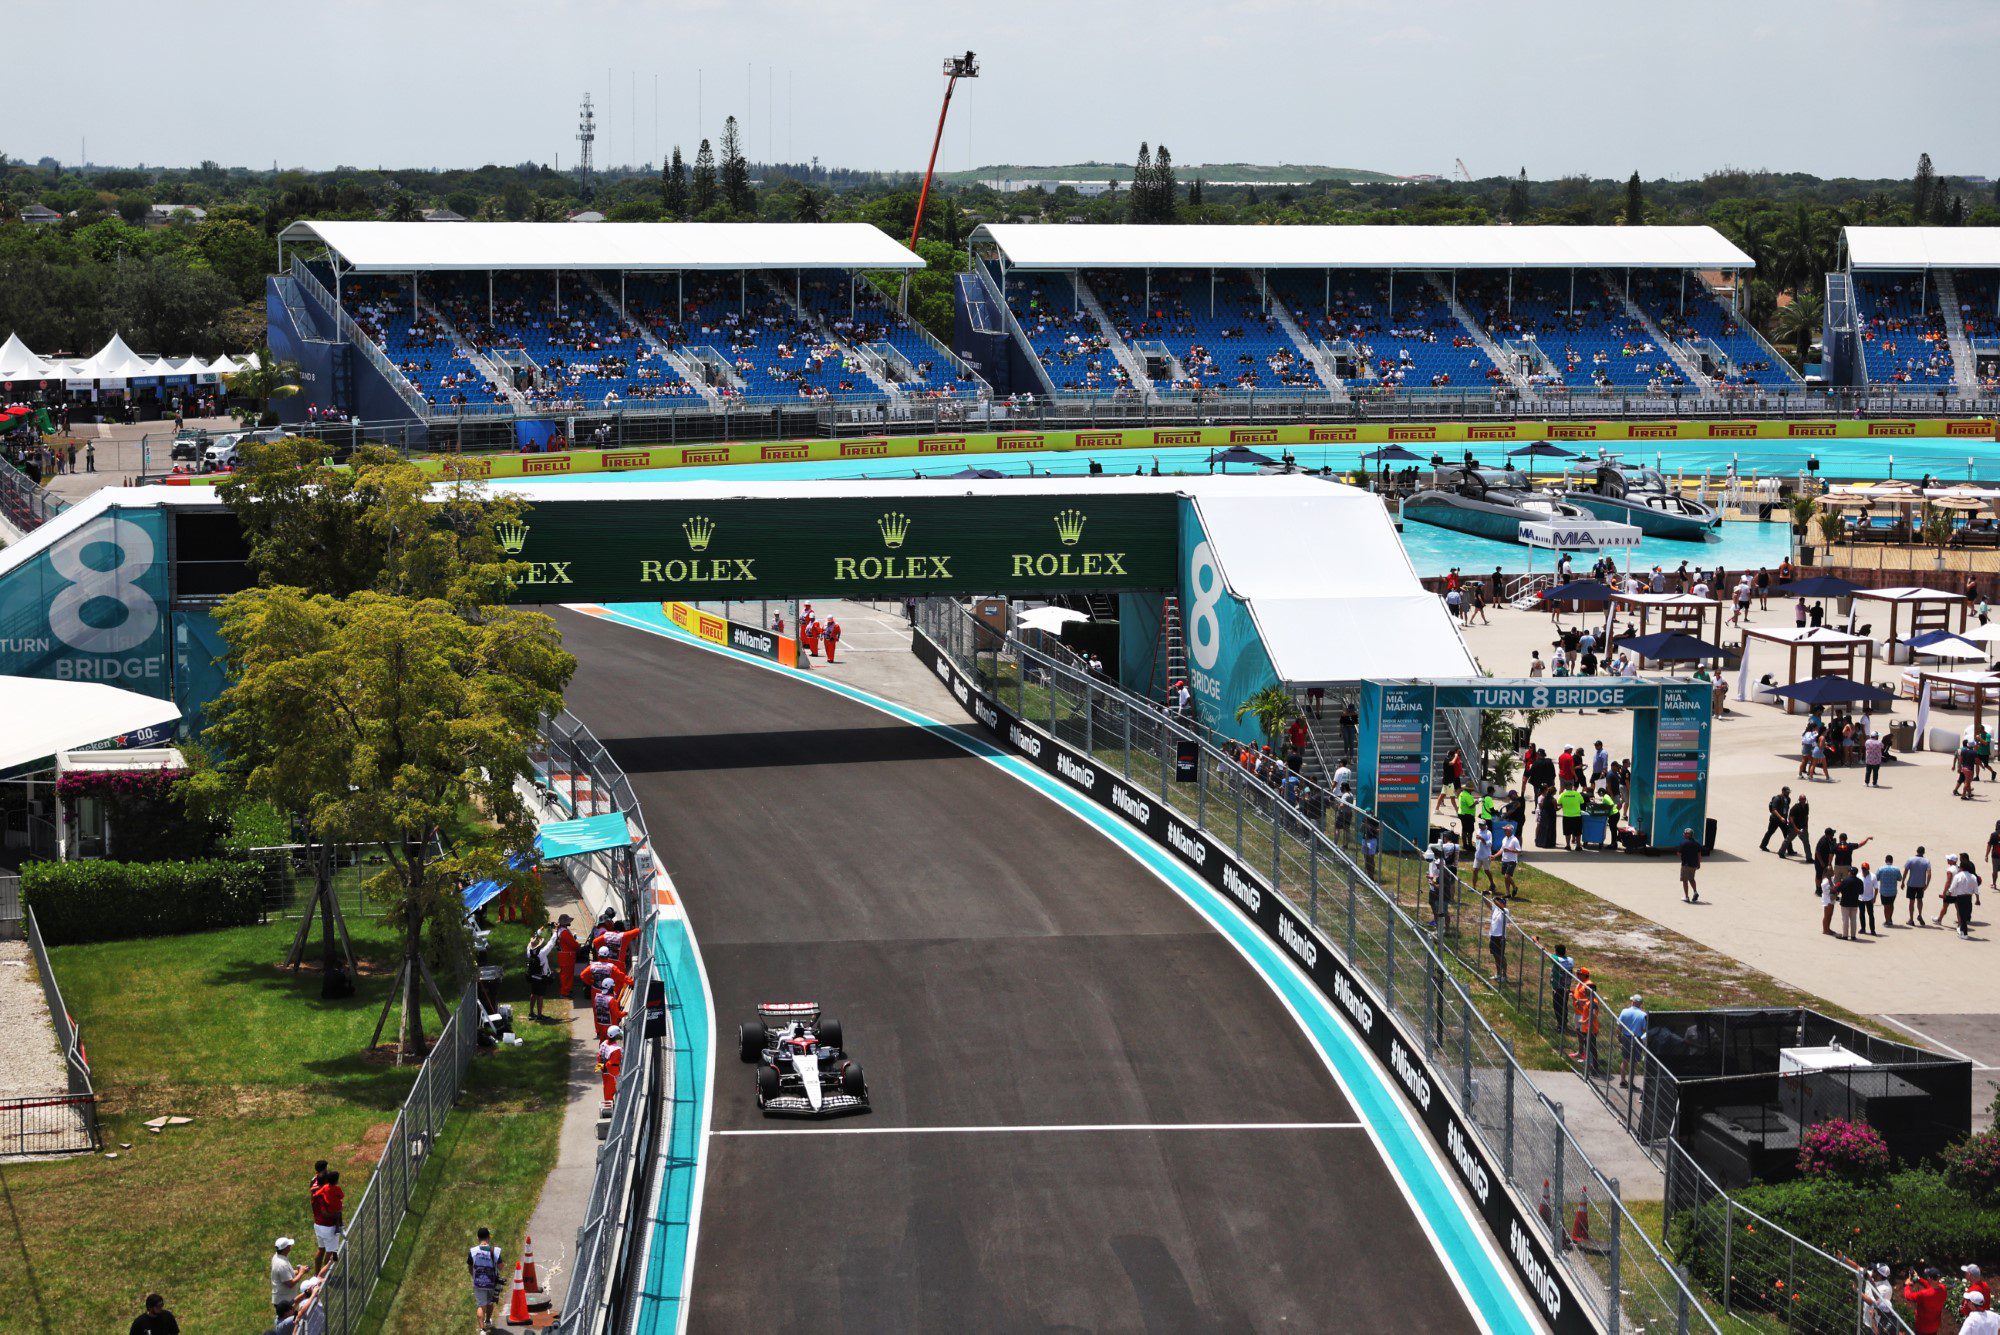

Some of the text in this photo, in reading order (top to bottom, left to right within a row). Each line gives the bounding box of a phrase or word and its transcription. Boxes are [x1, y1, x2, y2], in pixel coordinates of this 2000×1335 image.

[1309, 428, 1357, 440] PIRELLI
[1388, 427, 1436, 441] PIRELLI
[1468, 426, 1516, 438] PIRELLI
[1547, 426, 1596, 438] PIRELLI
[1628, 425, 1677, 438] PIRELLI
[1709, 425, 1757, 436] PIRELLI
[1788, 424, 1836, 436] PIRELLI
[1868, 423, 1916, 436] PIRELLI
[1946, 422, 1991, 434] PIRELLI
[997, 436, 1044, 449] PIRELLI
[1076, 433, 1122, 448] PIRELLI
[1154, 432, 1200, 444] PIRELLI
[1230, 430, 1277, 442] PIRELLI
[761, 445, 809, 459] PIRELLI
[840, 441, 887, 456] PIRELLI
[919, 438, 966, 452] PIRELLI
[602, 452, 650, 467] PIRELLI
[682, 448, 729, 463] PIRELLI
[523, 457, 571, 472] PIRELLI
[1553, 531, 1641, 546] MIA MARINA
[640, 558, 757, 582] ROLEX
[834, 555, 953, 580] ROLEX
[1011, 552, 1128, 577] ROLEX
[49, 517, 158, 653] 8
[1190, 541, 1224, 670] 8
[700, 617, 723, 641] PIRELLI
[0, 638, 50, 652] TURN
[734, 628, 772, 653] #MiamiGP
[56, 657, 160, 680] BRIDGE
[1191, 668, 1221, 701] BRIDGE
[1386, 695, 1404, 703] MIA
[1473, 687, 1624, 708] TURN 8 BRIDGE
[1664, 701, 1701, 709] MARINA
[1665, 694, 1682, 702] MIA
[1385, 703, 1423, 711] MARINA
[1010, 723, 1041, 758] #MiamiGP
[1057, 752, 1095, 790] #MiamiGP
[1112, 784, 1150, 825] #MiamiGP
[1168, 821, 1206, 866] #MiamiGP
[1223, 863, 1261, 914] #MiamiGP
[1278, 912, 1317, 969] #MiamiGP
[1334, 970, 1373, 1034] #MiamiGP
[1391, 1038, 1431, 1112] #MiamiGP
[1447, 1118, 1489, 1205] #MiamiGP
[1510, 1218, 1561, 1320] #MiamiGP
